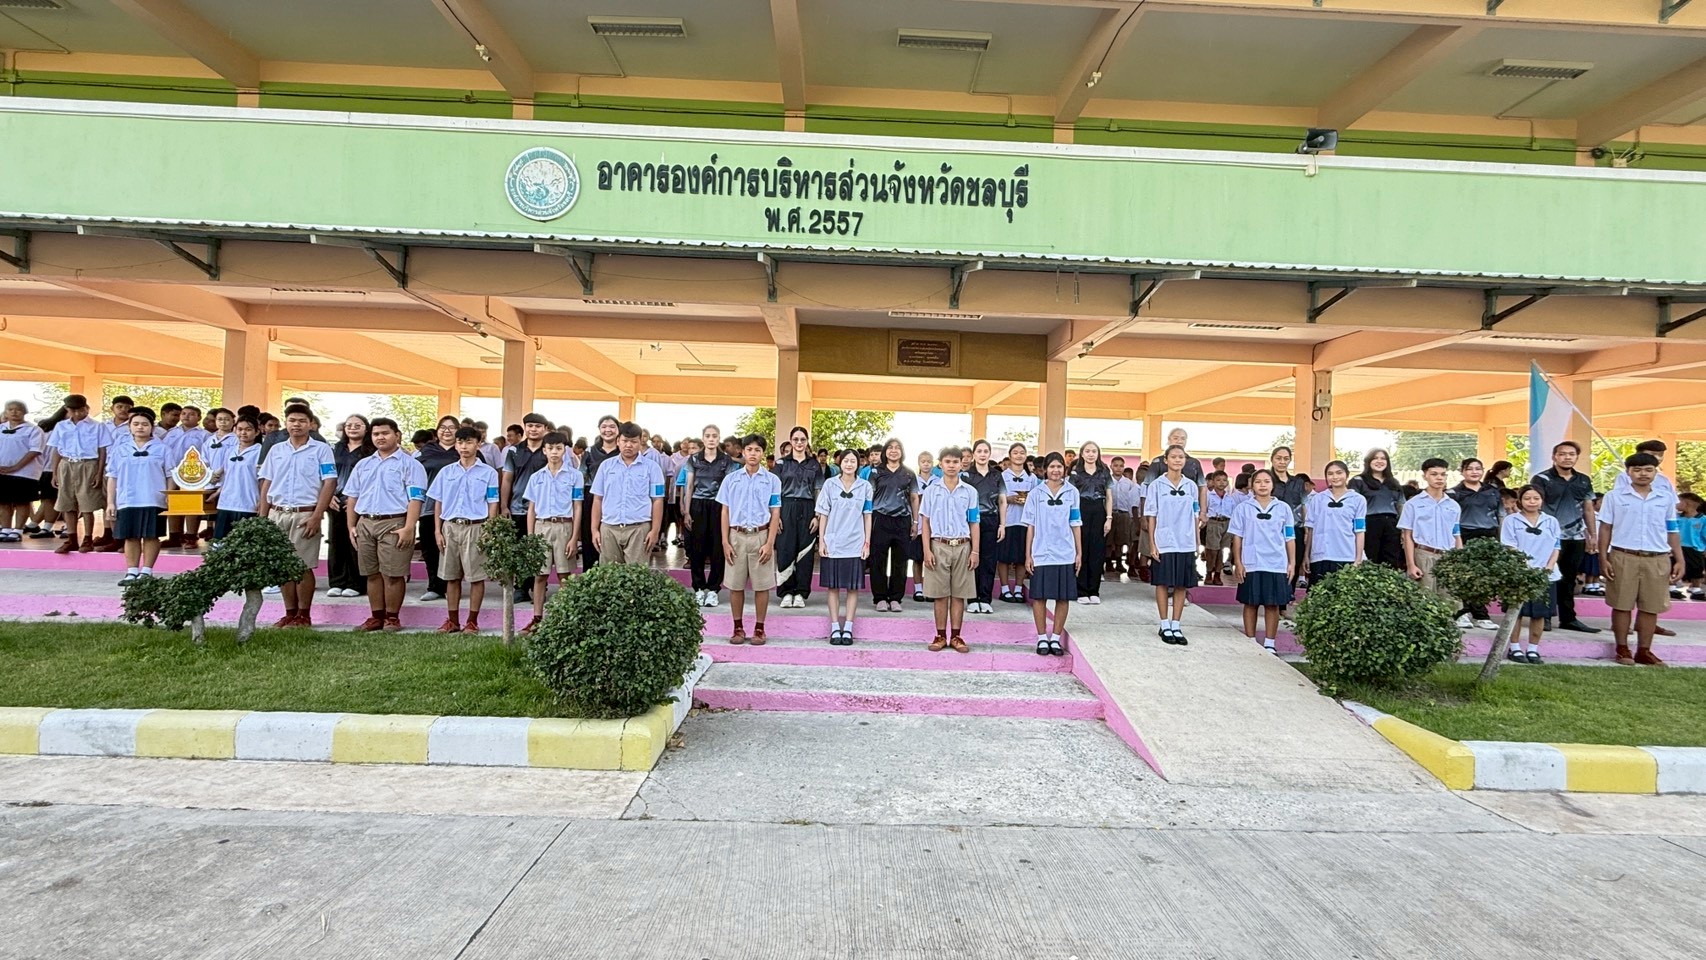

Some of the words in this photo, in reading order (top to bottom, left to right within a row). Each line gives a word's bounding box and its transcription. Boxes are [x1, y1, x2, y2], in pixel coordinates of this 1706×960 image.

[597, 153, 1029, 223] อาคารองค์การบริหารส่วนจังหวัดชลบุรี
[764, 206, 864, 236] พ.ศ.2557
